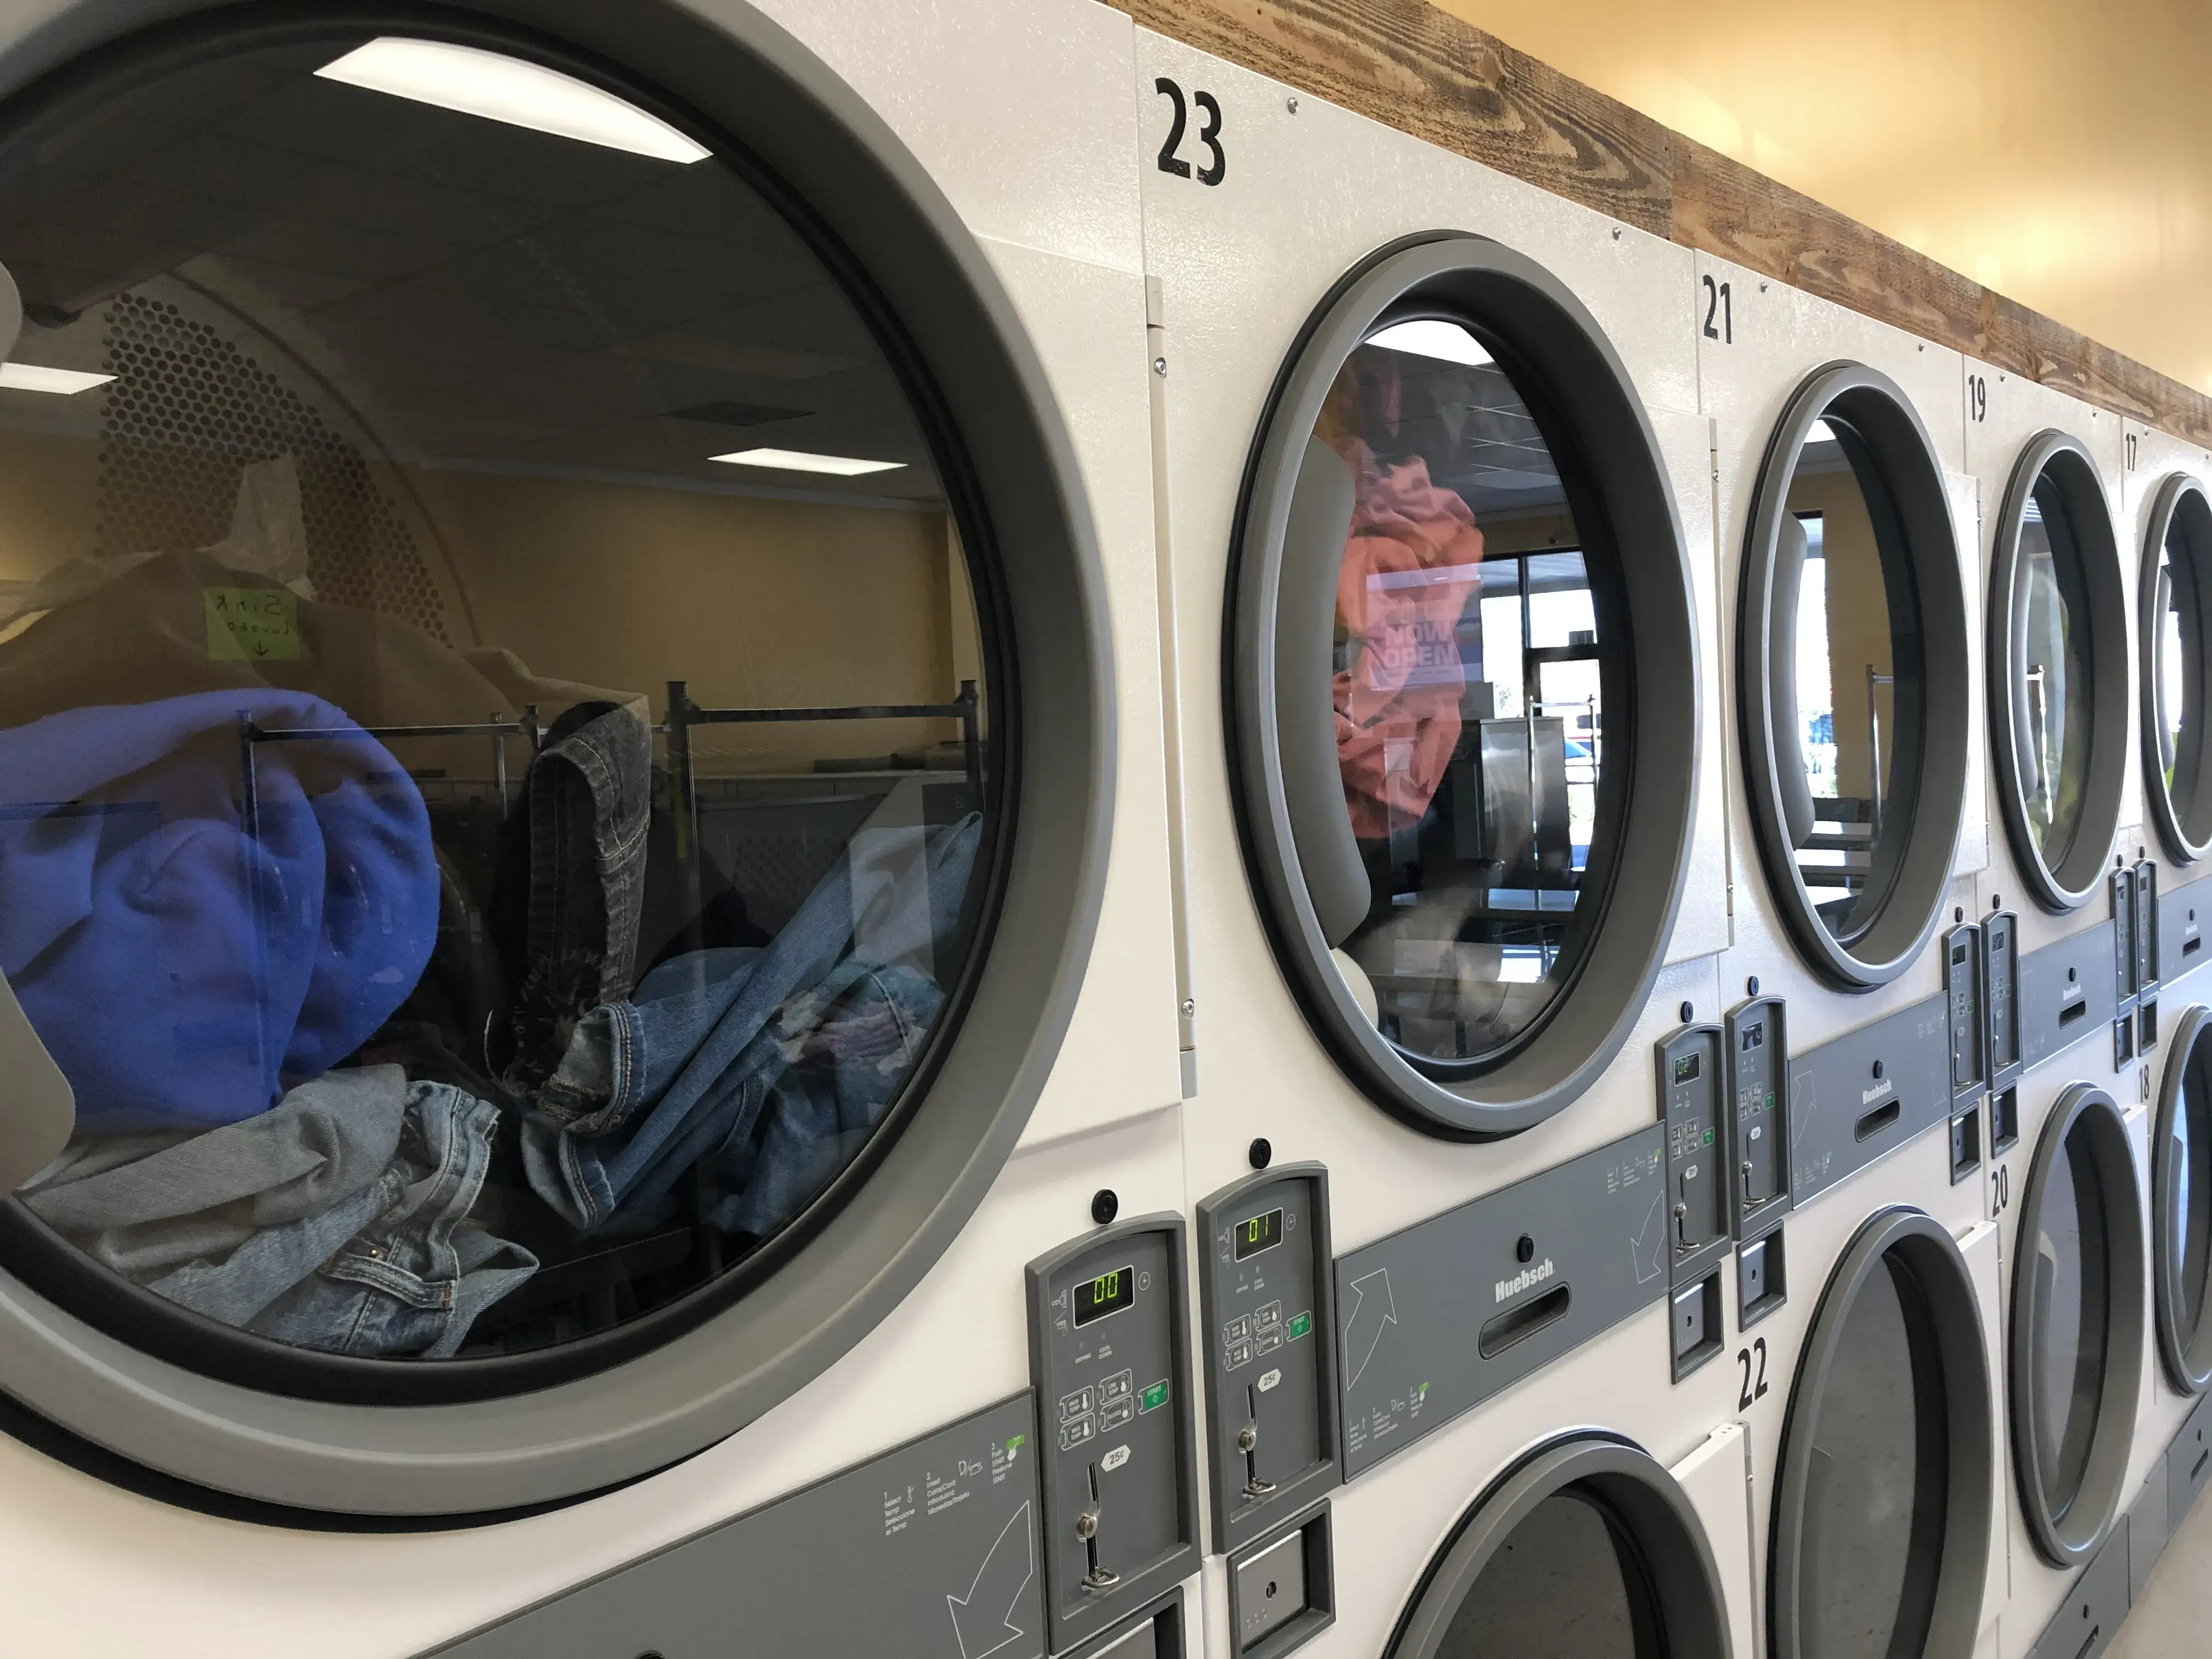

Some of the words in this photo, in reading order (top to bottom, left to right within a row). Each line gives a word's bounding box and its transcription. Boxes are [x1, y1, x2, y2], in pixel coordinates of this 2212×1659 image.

[1155, 77, 1225, 186] 23
[1703, 274, 1731, 345] 21
[1968, 374, 1986, 422] 19
[2125, 433, 2137, 472] 17
[1386, 621, 1451, 646] NOW
[1383, 643, 1455, 668] OPEN
[2139, 1064, 2149, 1103] 18
[1991, 1164, 2008, 1218] 20
[1248, 1214, 1269, 1243] 01
[1093, 1272, 1119, 1304] 00
[1495, 1258, 1554, 1303] Huebsch
[1263, 1373, 1277, 1387] 25¢
[1737, 1337, 1768, 1413] 22
[1147, 1385, 1161, 1397] START
[1070, 1431, 1081, 1441] TEMP
[1109, 1447, 1125, 1464] 25¢
[926, 1472, 931, 1480] 2
[883, 1492, 888, 1500] 1
[884, 1506, 900, 1518] Temp
[891, 1521, 907, 1533] Temp
